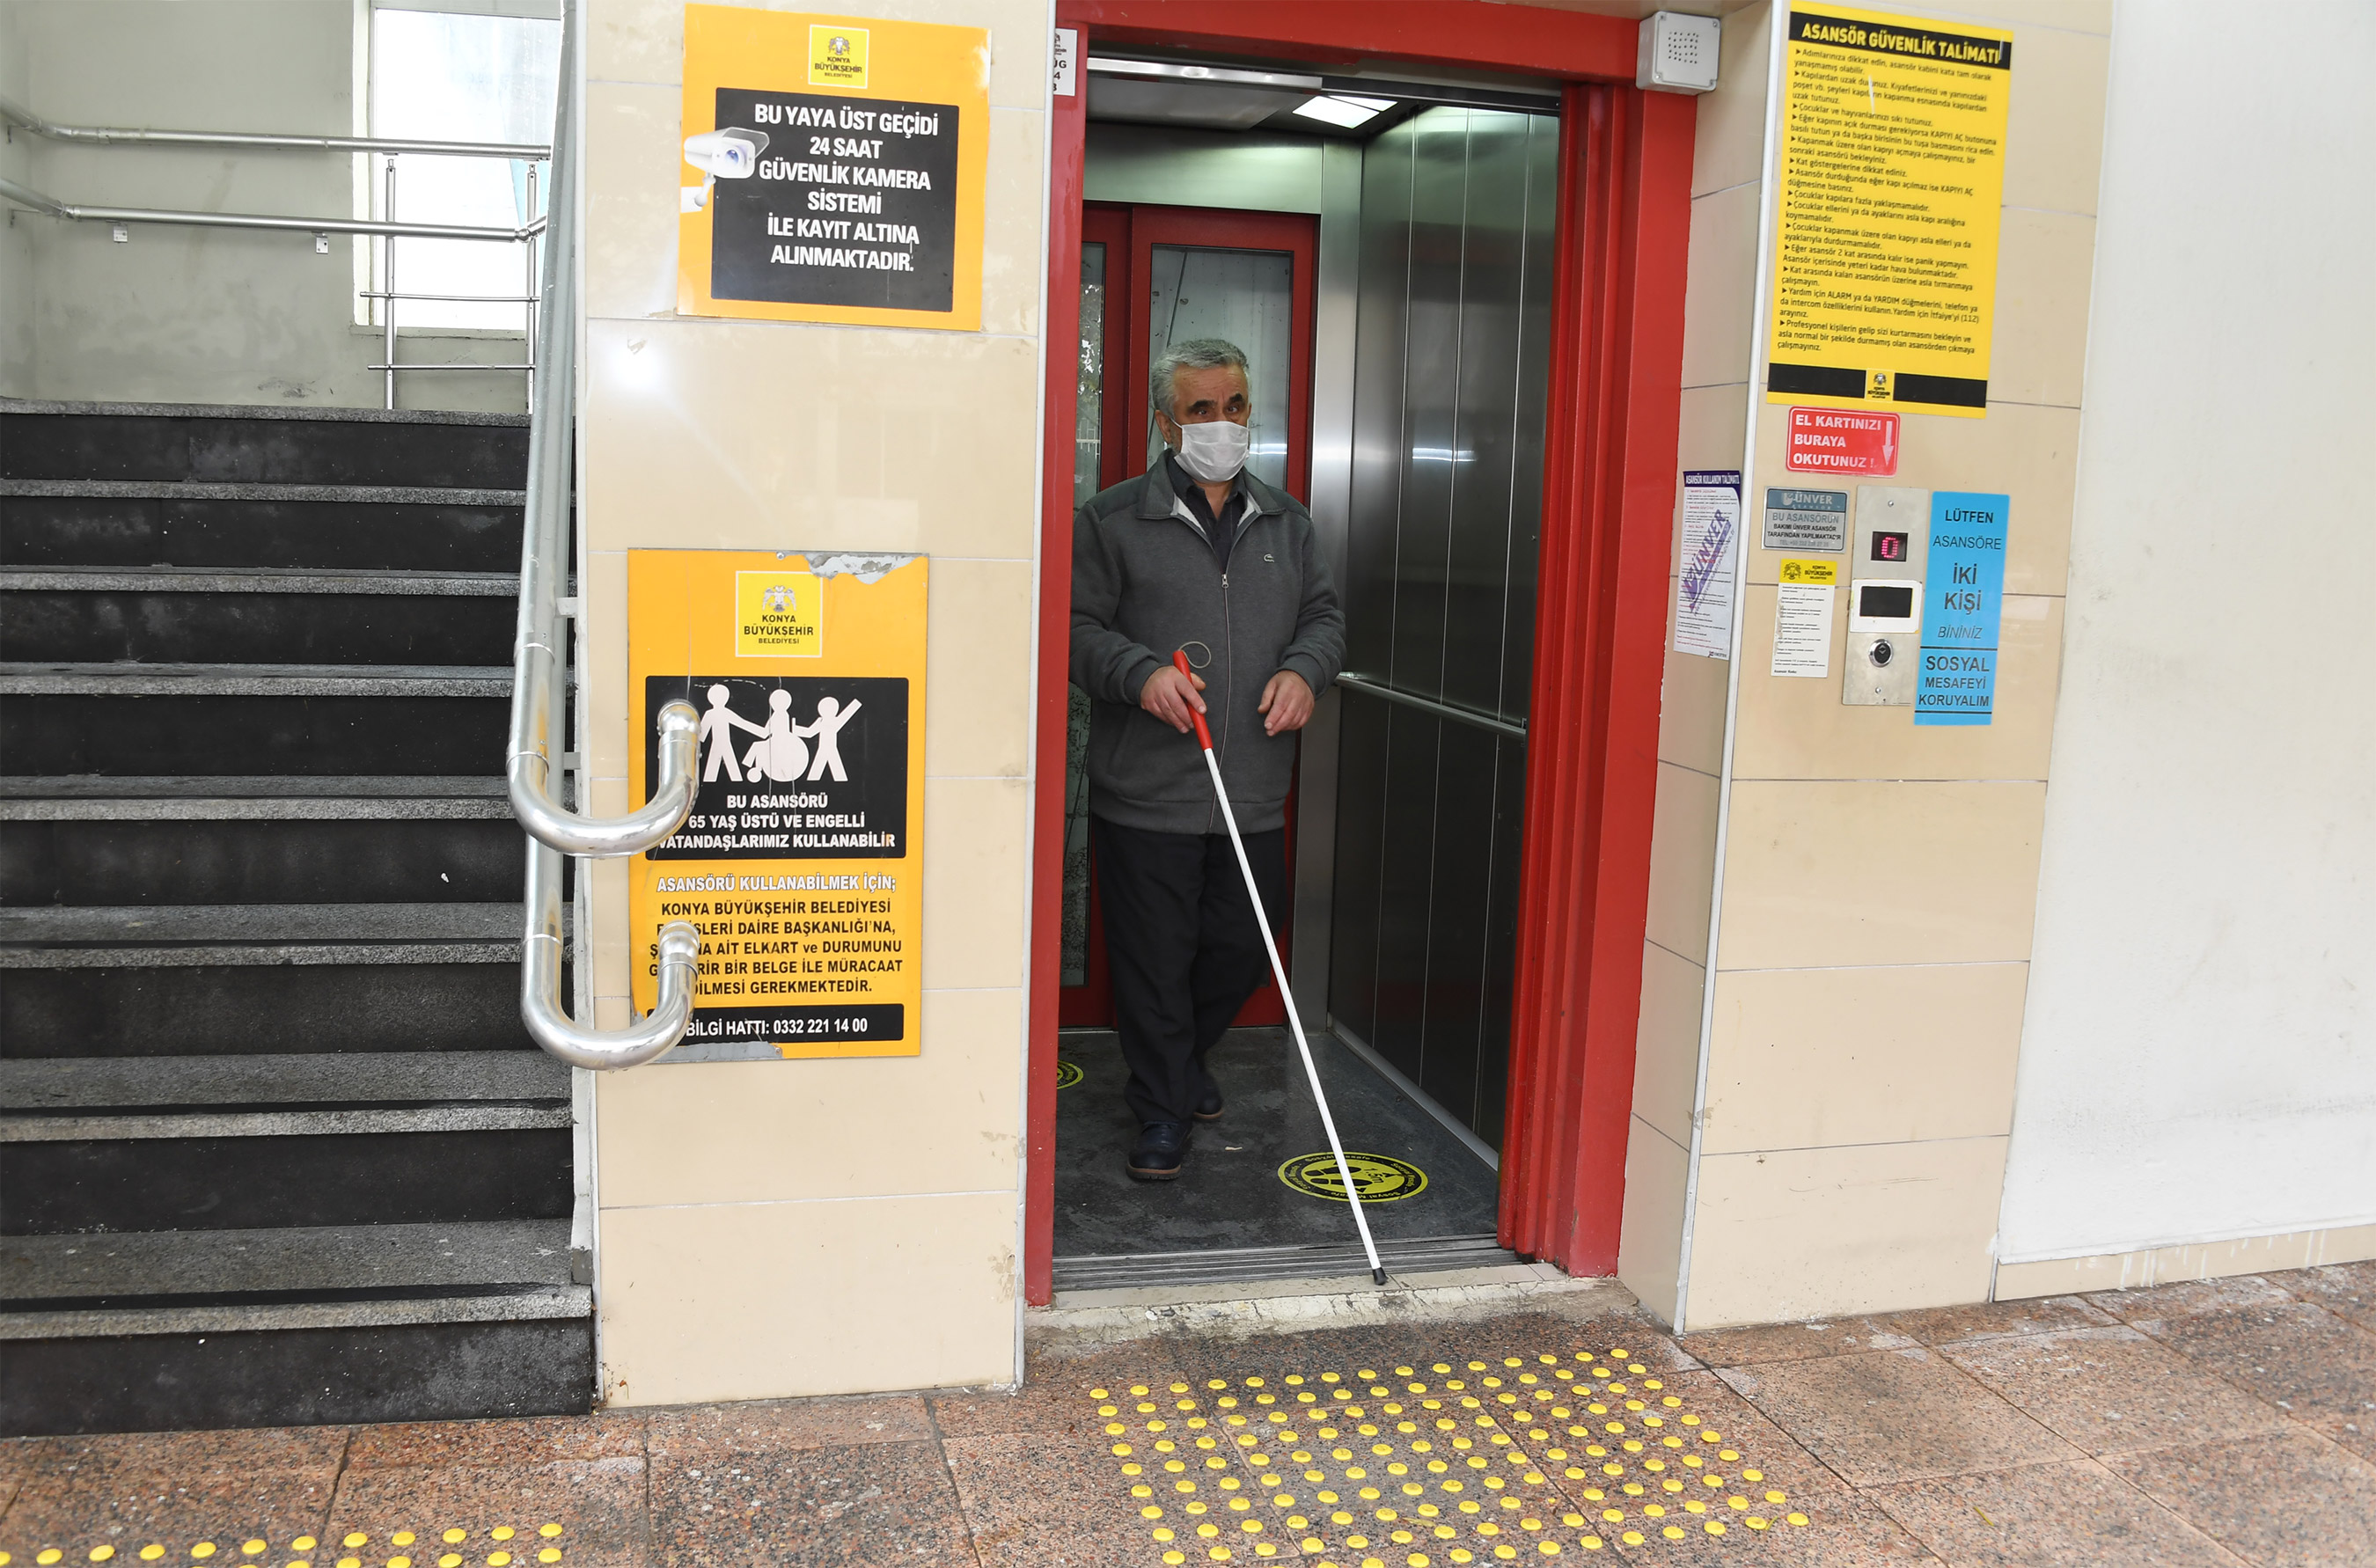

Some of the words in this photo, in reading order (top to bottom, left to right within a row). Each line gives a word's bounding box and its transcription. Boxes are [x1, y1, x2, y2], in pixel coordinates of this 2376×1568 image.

[1801, 23, 1866, 46] ASANSÖR
[1868, 30, 1936, 55] GÜVENLİK
[1938, 43, 2001, 64] TALİMATI
[814, 62, 862, 73] BÜYÜKŞEHİR
[755, 103, 781, 124] BU
[785, 106, 837, 128] YAYA
[840, 110, 876, 131] ÜST
[879, 113, 938, 138] GEÇİDİ
[810, 136, 831, 156] 24
[832, 137, 884, 159] SAAT
[759, 158, 850, 185] GÜVENLİK
[853, 166, 931, 191] KAMERA
[807, 191, 882, 215] SİSTEMİ
[1786, 210, 1832, 223] koymamalıdır.
[767, 212, 794, 237] İLE
[797, 218, 852, 240] KAYIT
[853, 222, 920, 246] ALTINA
[770, 245, 914, 272] ALINMAKTADIR.
[1781, 276, 1820, 288] çalışmayın.
[1777, 341, 1822, 352] çalışmayınız.
[1795, 414, 1812, 426] EL
[1815, 415, 1881, 430] KARTINIZI
[1794, 433, 1846, 448] BURAYA
[1793, 452, 1866, 468] OKUTUNUZ
[1685, 473, 1703, 484] ASANSÖR
[1702, 474, 1722, 484] KULLANIM
[1721, 474, 1740, 484] TALİMATI
[1795, 491, 1832, 504] ÜNVER
[1772, 512, 1785, 522] BU
[1786, 513, 1839, 524] ASANSÖRÜN
[1945, 508, 1993, 524] LÜTFEN
[1881, 536, 1898, 559] 0
[1932, 535, 2002, 550] ASANSÖRE
[1953, 562, 1977, 585] İKİ
[1944, 590, 1982, 615] KİŞİ
[762, 614, 796, 623] KONYA
[744, 626, 813, 636] BÜYÜKŞEHİR
[1935, 623, 1985, 642] BİNİNİZ
[1924, 654, 1990, 672] SOSYAL
[1925, 673, 1986, 692] MESAFEYİ
[1918, 692, 1989, 707] KORUYALIM
[727, 795, 747, 809] BU
[750, 792, 828, 809] ASANSÖRÜ
[688, 815, 706, 829] 65
[709, 815, 737, 832] YAŞ
[741, 812, 780, 829] ÜSTÜ
[782, 814, 803, 828] VE
[806, 811, 865, 828] ENGELLİ
[793, 831, 895, 848] KULLANABİLİR
[657, 874, 735, 892] ASANSÖRÜ
[740, 872, 859, 890] KULLANABİLMEK
[863, 872, 896, 893] İÇİN;
[662, 903, 710, 916] KONYA
[715, 898, 806, 918] BÜYÜKŞEHİR
[810, 898, 891, 913] BELEDİYESİ
[738, 919, 779, 934] DAİRE
[784, 918, 895, 937] BAŞKANLIĞI'NA,
[716, 939, 739, 955] AİT
[744, 942, 798, 955] ELKART
[803, 944, 818, 954] ve
[823, 940, 901, 953] DURUMUNU
[724, 959, 748, 975] BİR
[752, 961, 797, 974] BELGE
[802, 958, 823, 973] İLE
[828, 959, 903, 972] MÜRACAAT
[750, 977, 872, 994] GEREKMEKTEDİR.
[686, 1018, 722, 1037] BİLGİ
[726, 1020, 769, 1038] HATTI:
[774, 1019, 804, 1034] 0332
[807, 1018, 829, 1033] 221
[834, 1018, 849, 1032] 14
[852, 1018, 868, 1032] 00
